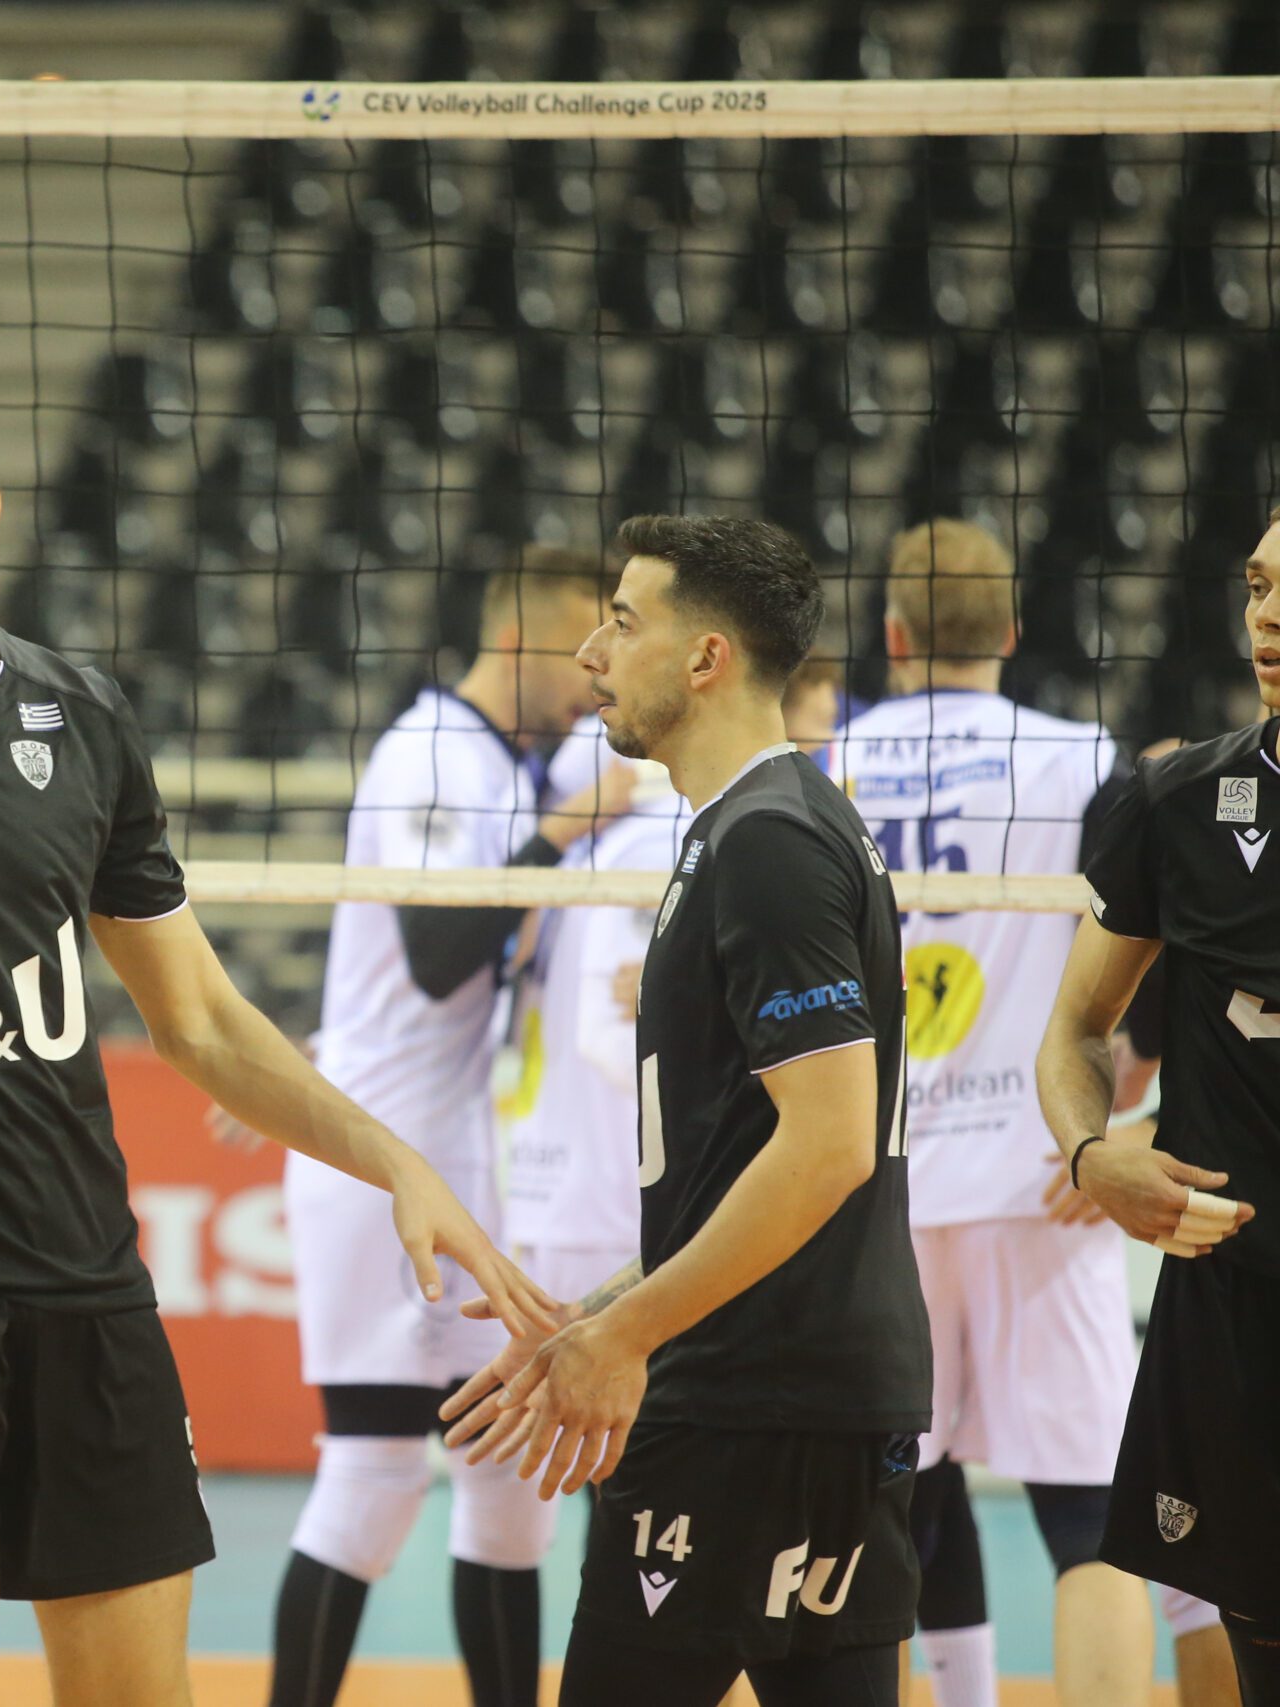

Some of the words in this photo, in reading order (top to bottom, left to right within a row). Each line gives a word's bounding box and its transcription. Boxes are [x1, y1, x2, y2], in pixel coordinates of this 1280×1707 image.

[363, 92, 410, 112] CEV
[419, 92, 528, 115] Volleyball
[534, 92, 651, 117] Challenge
[658, 91, 705, 115] Cup
[711, 91, 768, 111] 2025
[1219, 807, 1255, 815] VOLLEY
[773, 980, 861, 1020] avance
[632, 1508, 692, 1562] 14
